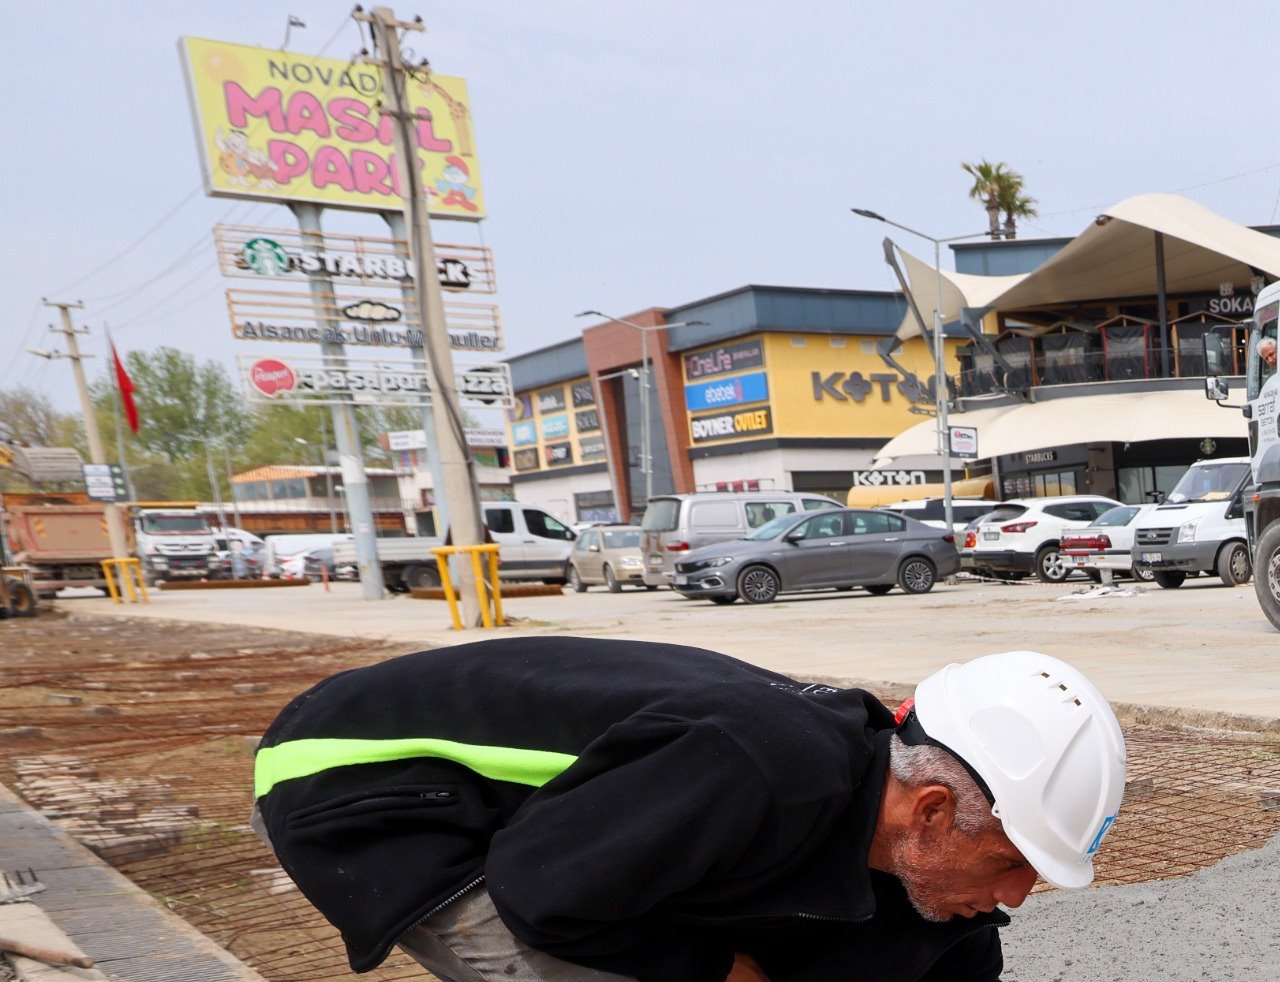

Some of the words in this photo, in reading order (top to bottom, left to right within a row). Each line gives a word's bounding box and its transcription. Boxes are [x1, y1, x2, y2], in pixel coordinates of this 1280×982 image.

[268, 59, 385, 95] NOVAD
[1209, 297, 1256, 313] SOKA
[241, 321, 345, 344] Alsancak
[406, 330, 500, 352] Muller
[311, 369, 429, 392] pasapor
[691, 416, 735, 438] BOYNER
[735, 410, 768, 432] OUTLET
[1025, 450, 1054, 464] STARBUCKS
[853, 471, 927, 485] KOTON
